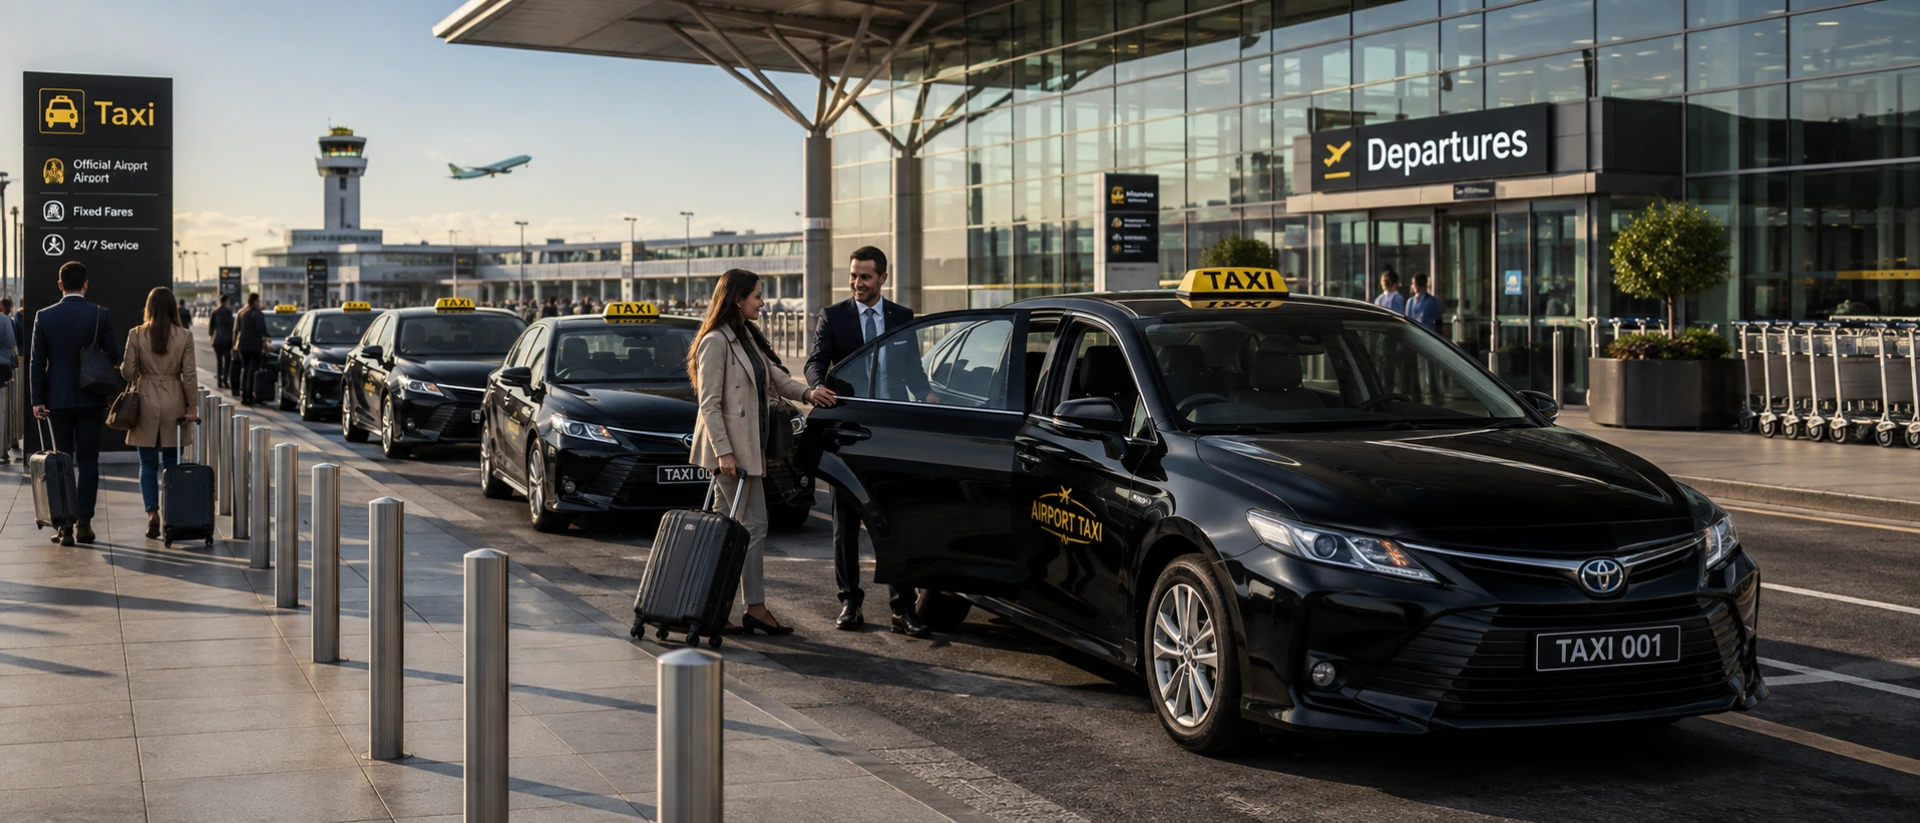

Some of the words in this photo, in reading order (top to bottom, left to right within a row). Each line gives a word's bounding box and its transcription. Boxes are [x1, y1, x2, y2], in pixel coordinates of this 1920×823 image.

[94, 101, 154, 126] Taxi
[1368, 129, 1528, 176] Departures
[73, 159, 111, 170] Official
[73, 172, 109, 183] Airport
[73, 206, 102, 216] Fixed
[104, 206, 134, 217] Fares
[73, 240, 98, 251] 24/7
[100, 240, 139, 250] Service
[1203, 271, 1275, 290] TAXI
[443, 299, 470, 307] TAXI
[613, 303, 651, 314] TAXI
[664, 468, 694, 480] TAXI
[1031, 500, 1075, 532] AIRPORT
[1078, 515, 1103, 542] TAXI
[1556, 636, 1613, 663] TAXI
[1621, 633, 1661, 659] 001
